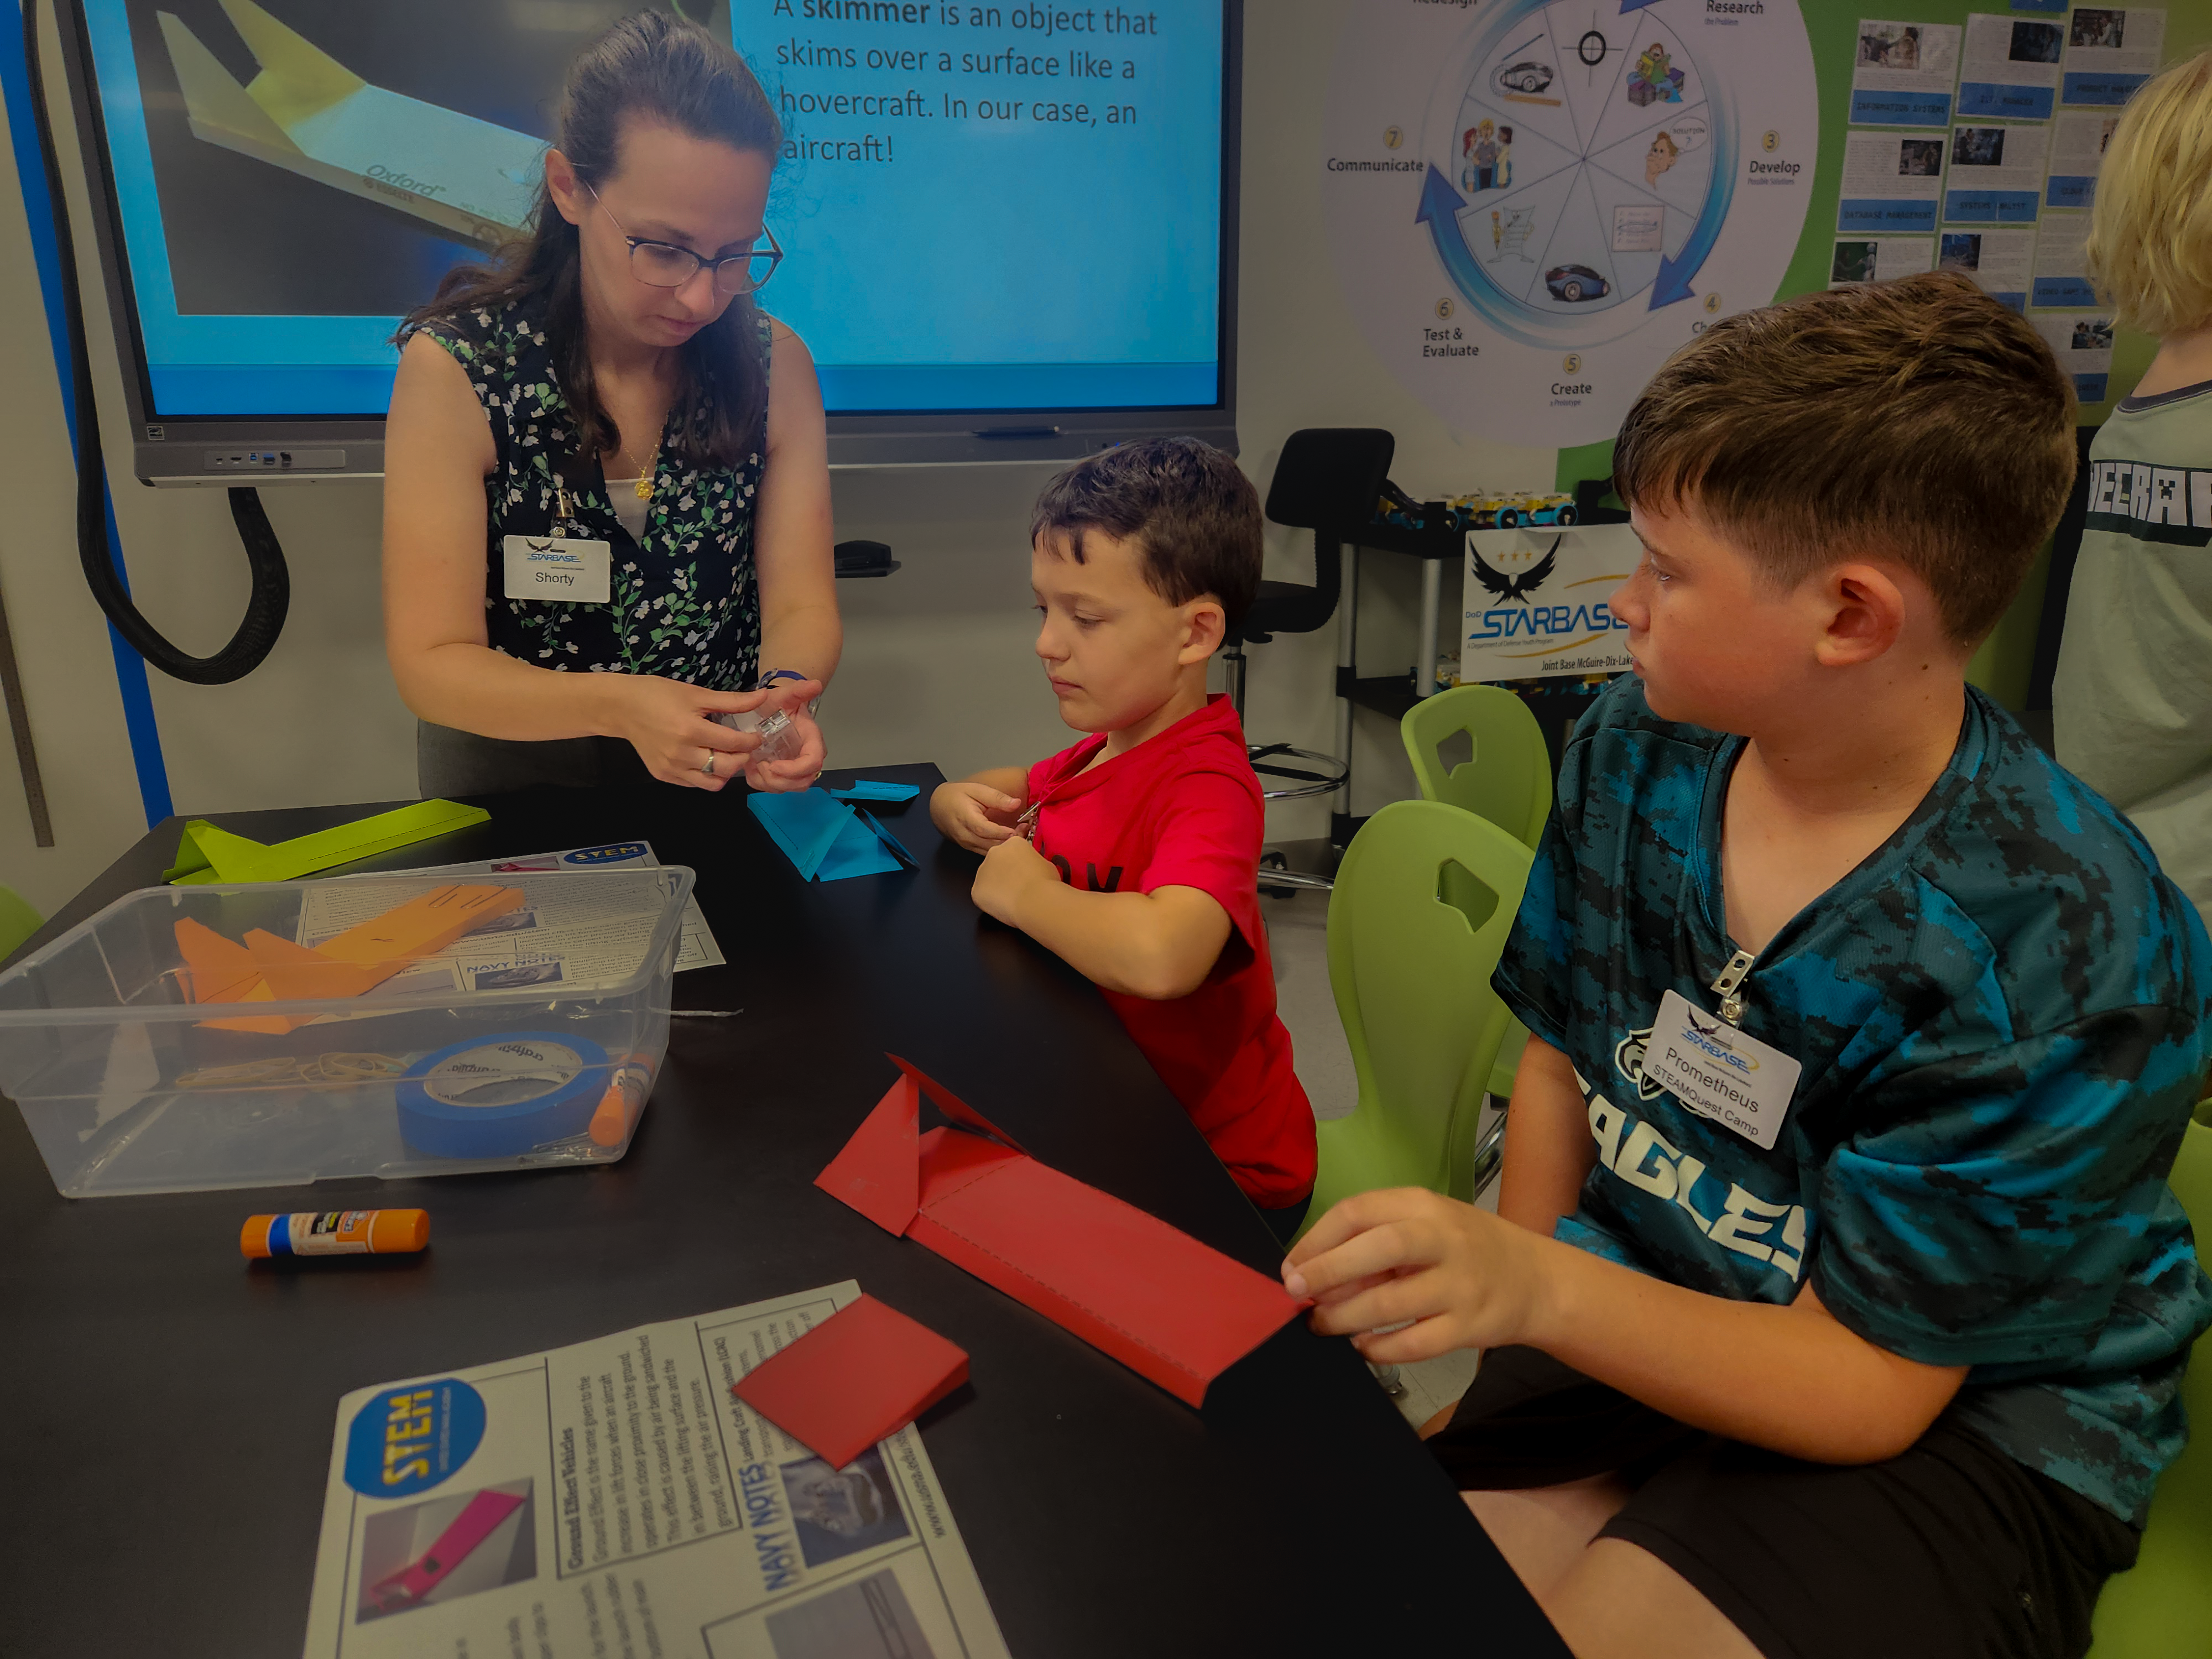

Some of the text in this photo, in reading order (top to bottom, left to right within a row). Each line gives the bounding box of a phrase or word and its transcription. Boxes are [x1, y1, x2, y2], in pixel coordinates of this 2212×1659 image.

[774, 0, 1157, 37] A skimmer is an object that
[1706, 1, 1765, 14] Research
[776, 39, 1135, 79] skims over a surface like a
[780, 86, 1137, 128] hovercraft. In our case, an
[784, 134, 895, 163] aircraft!
[1327, 157, 1424, 173] Communicate
[1749, 160, 1801, 176] Develop
[366, 165, 437, 196] Oxford
[1423, 327, 1463, 341] Test &
[1422, 344, 1480, 358] Evaluate
[1551, 382, 1593, 395] Create
[527, 554, 581, 562] STARBASE
[535, 572, 575, 586] Shorty
[1541, 659, 1559, 671] Joint
[1560, 659, 1575, 670] Base
[575, 846, 639, 860] STEM
[467, 961, 510, 974] NAVY
[1680, 1029, 1751, 1074] STARBASE
[1665, 1047, 1759, 1114] Prometheus
[1653, 1064, 1721, 1115] STEAMQuest
[1724, 1109, 1759, 1137] Camp
[1574, 1065, 1806, 1283] AGLES
[382, 1390, 435, 1486] STEM
[737, 1464, 787, 1592] NAVY NOTES
